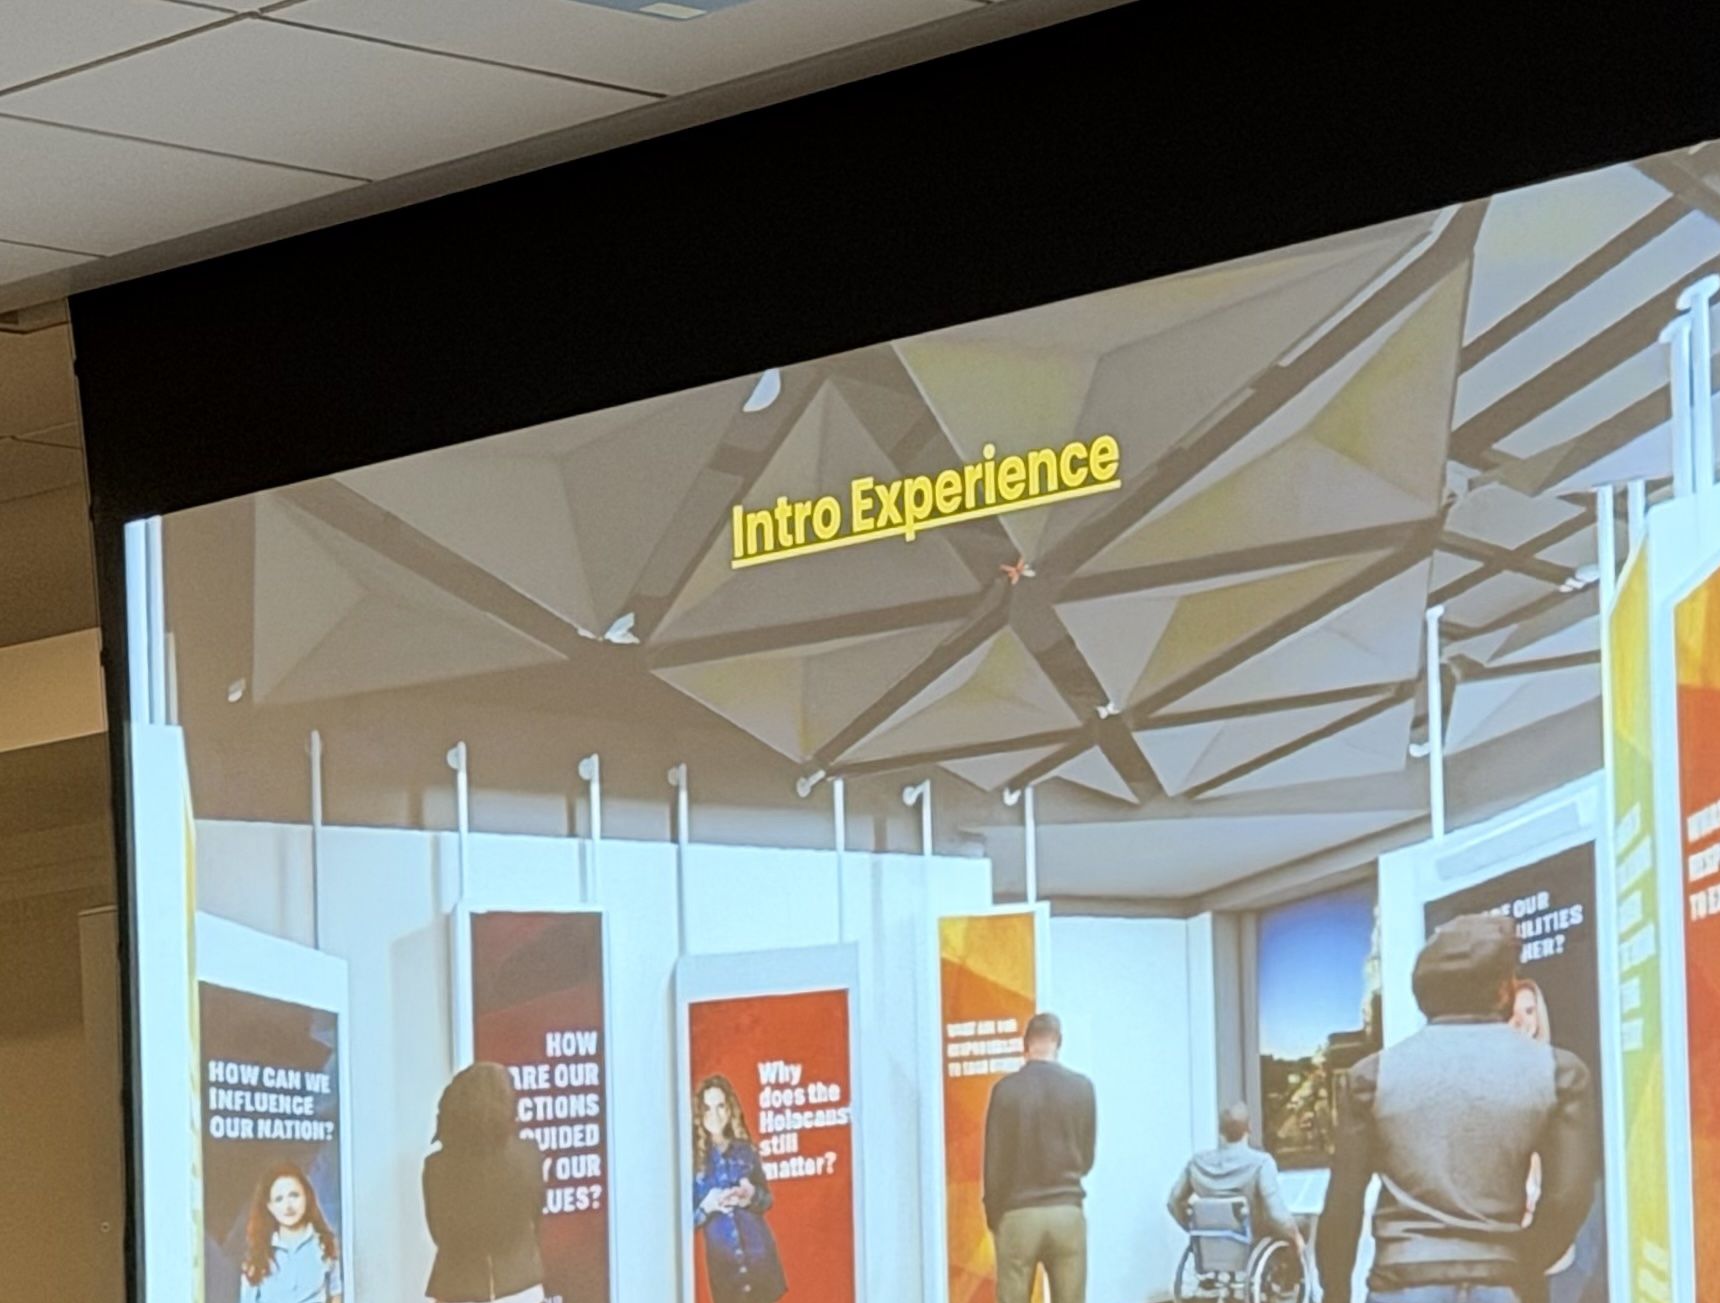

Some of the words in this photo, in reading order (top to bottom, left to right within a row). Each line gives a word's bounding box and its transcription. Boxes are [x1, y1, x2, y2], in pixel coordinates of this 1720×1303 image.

[732, 495, 841, 558] Intro
[850, 434, 1121, 543] Experience
[1513, 891, 1549, 918] OUR
[1520, 934, 1566, 964] HER?
[546, 1031, 598, 1057] HOW
[208, 1060, 260, 1086] HOW
[262, 1067, 301, 1090] CAN
[304, 1072, 331, 1094] WE
[554, 1062, 600, 1088] OUR
[757, 1060, 802, 1086] Why
[209, 1086, 314, 1116] INFLUENCE
[515, 1094, 600, 1122] CTIONS
[759, 1086, 806, 1109] does
[808, 1081, 841, 1104] the
[209, 1115, 254, 1139] OUR
[257, 1118, 335, 1141] NATION?
[758, 1132, 798, 1157] still
[556, 1154, 602, 1180] OUR
[542, 1184, 602, 1214] UES?
